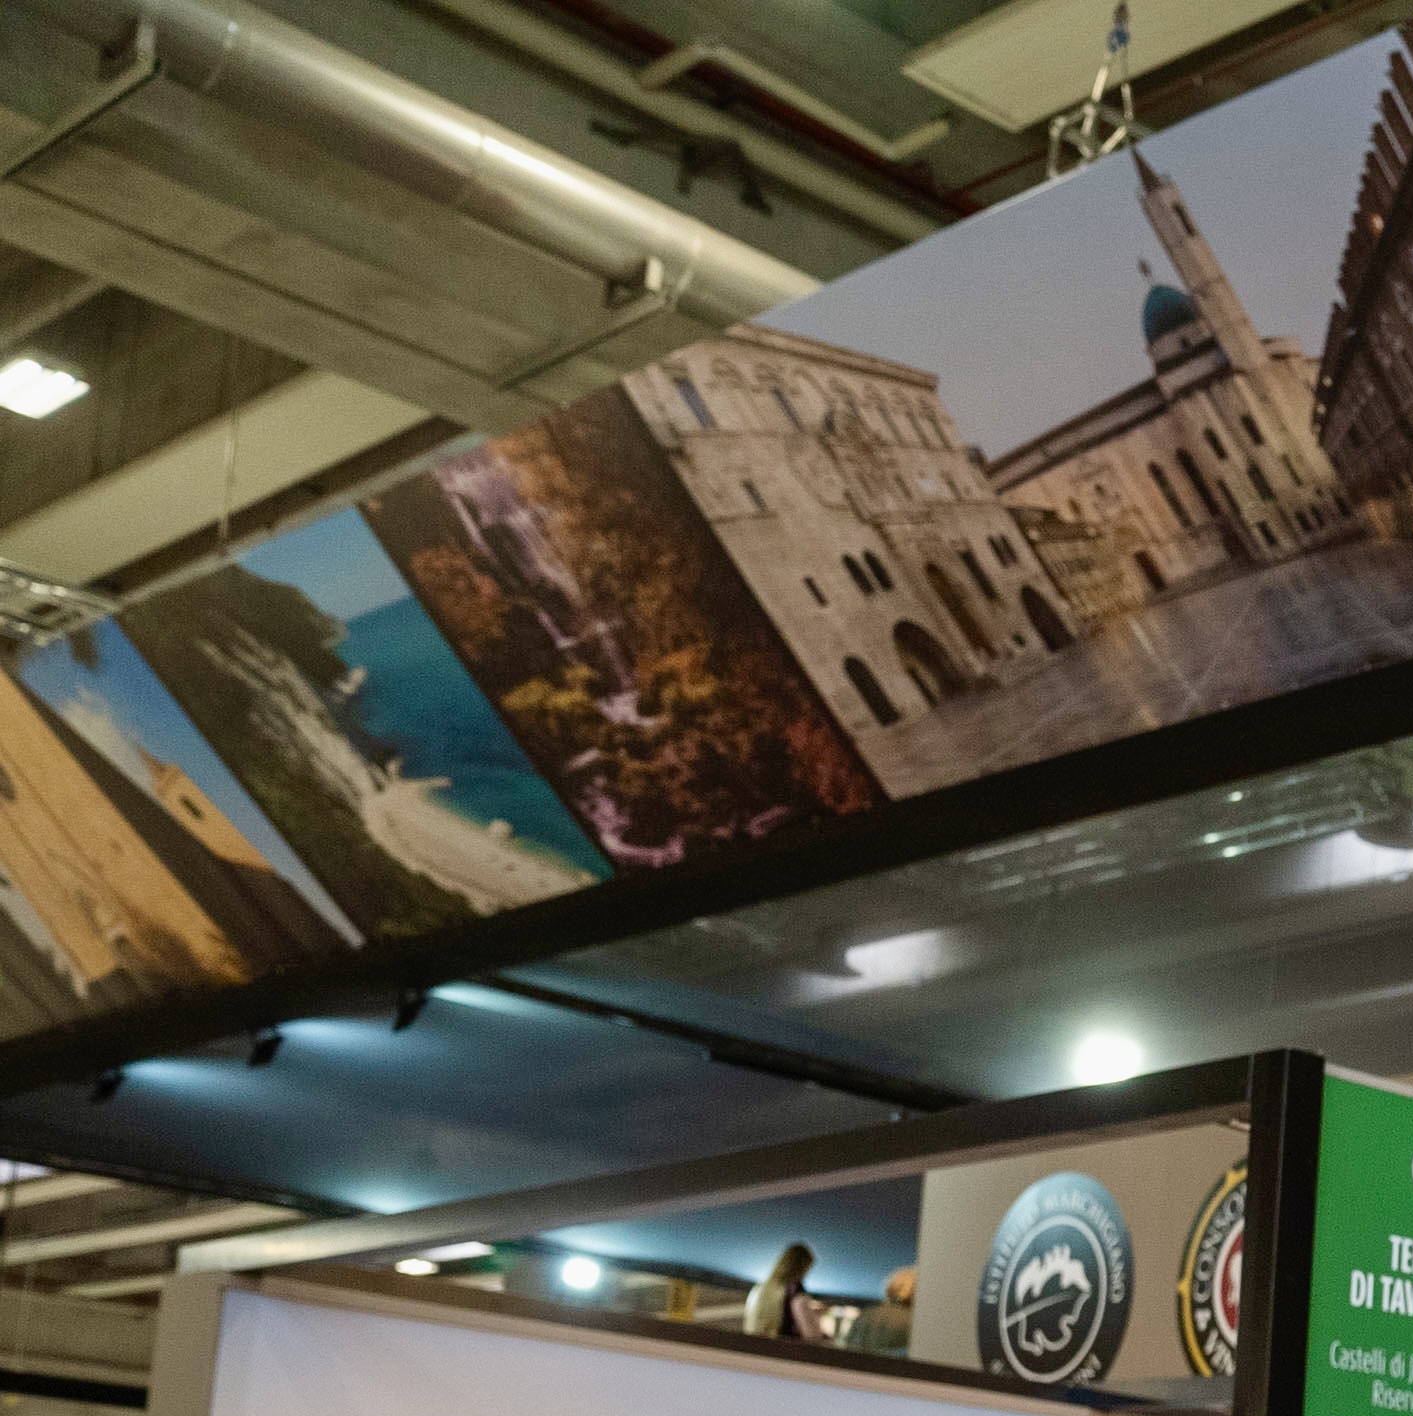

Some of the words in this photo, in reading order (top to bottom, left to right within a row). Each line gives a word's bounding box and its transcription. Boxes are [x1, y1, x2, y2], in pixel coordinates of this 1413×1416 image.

[1350, 1269, 1375, 1310] DI
[1329, 1339, 1386, 1376] Castelli
[1388, 1350, 1406, 1379] di
